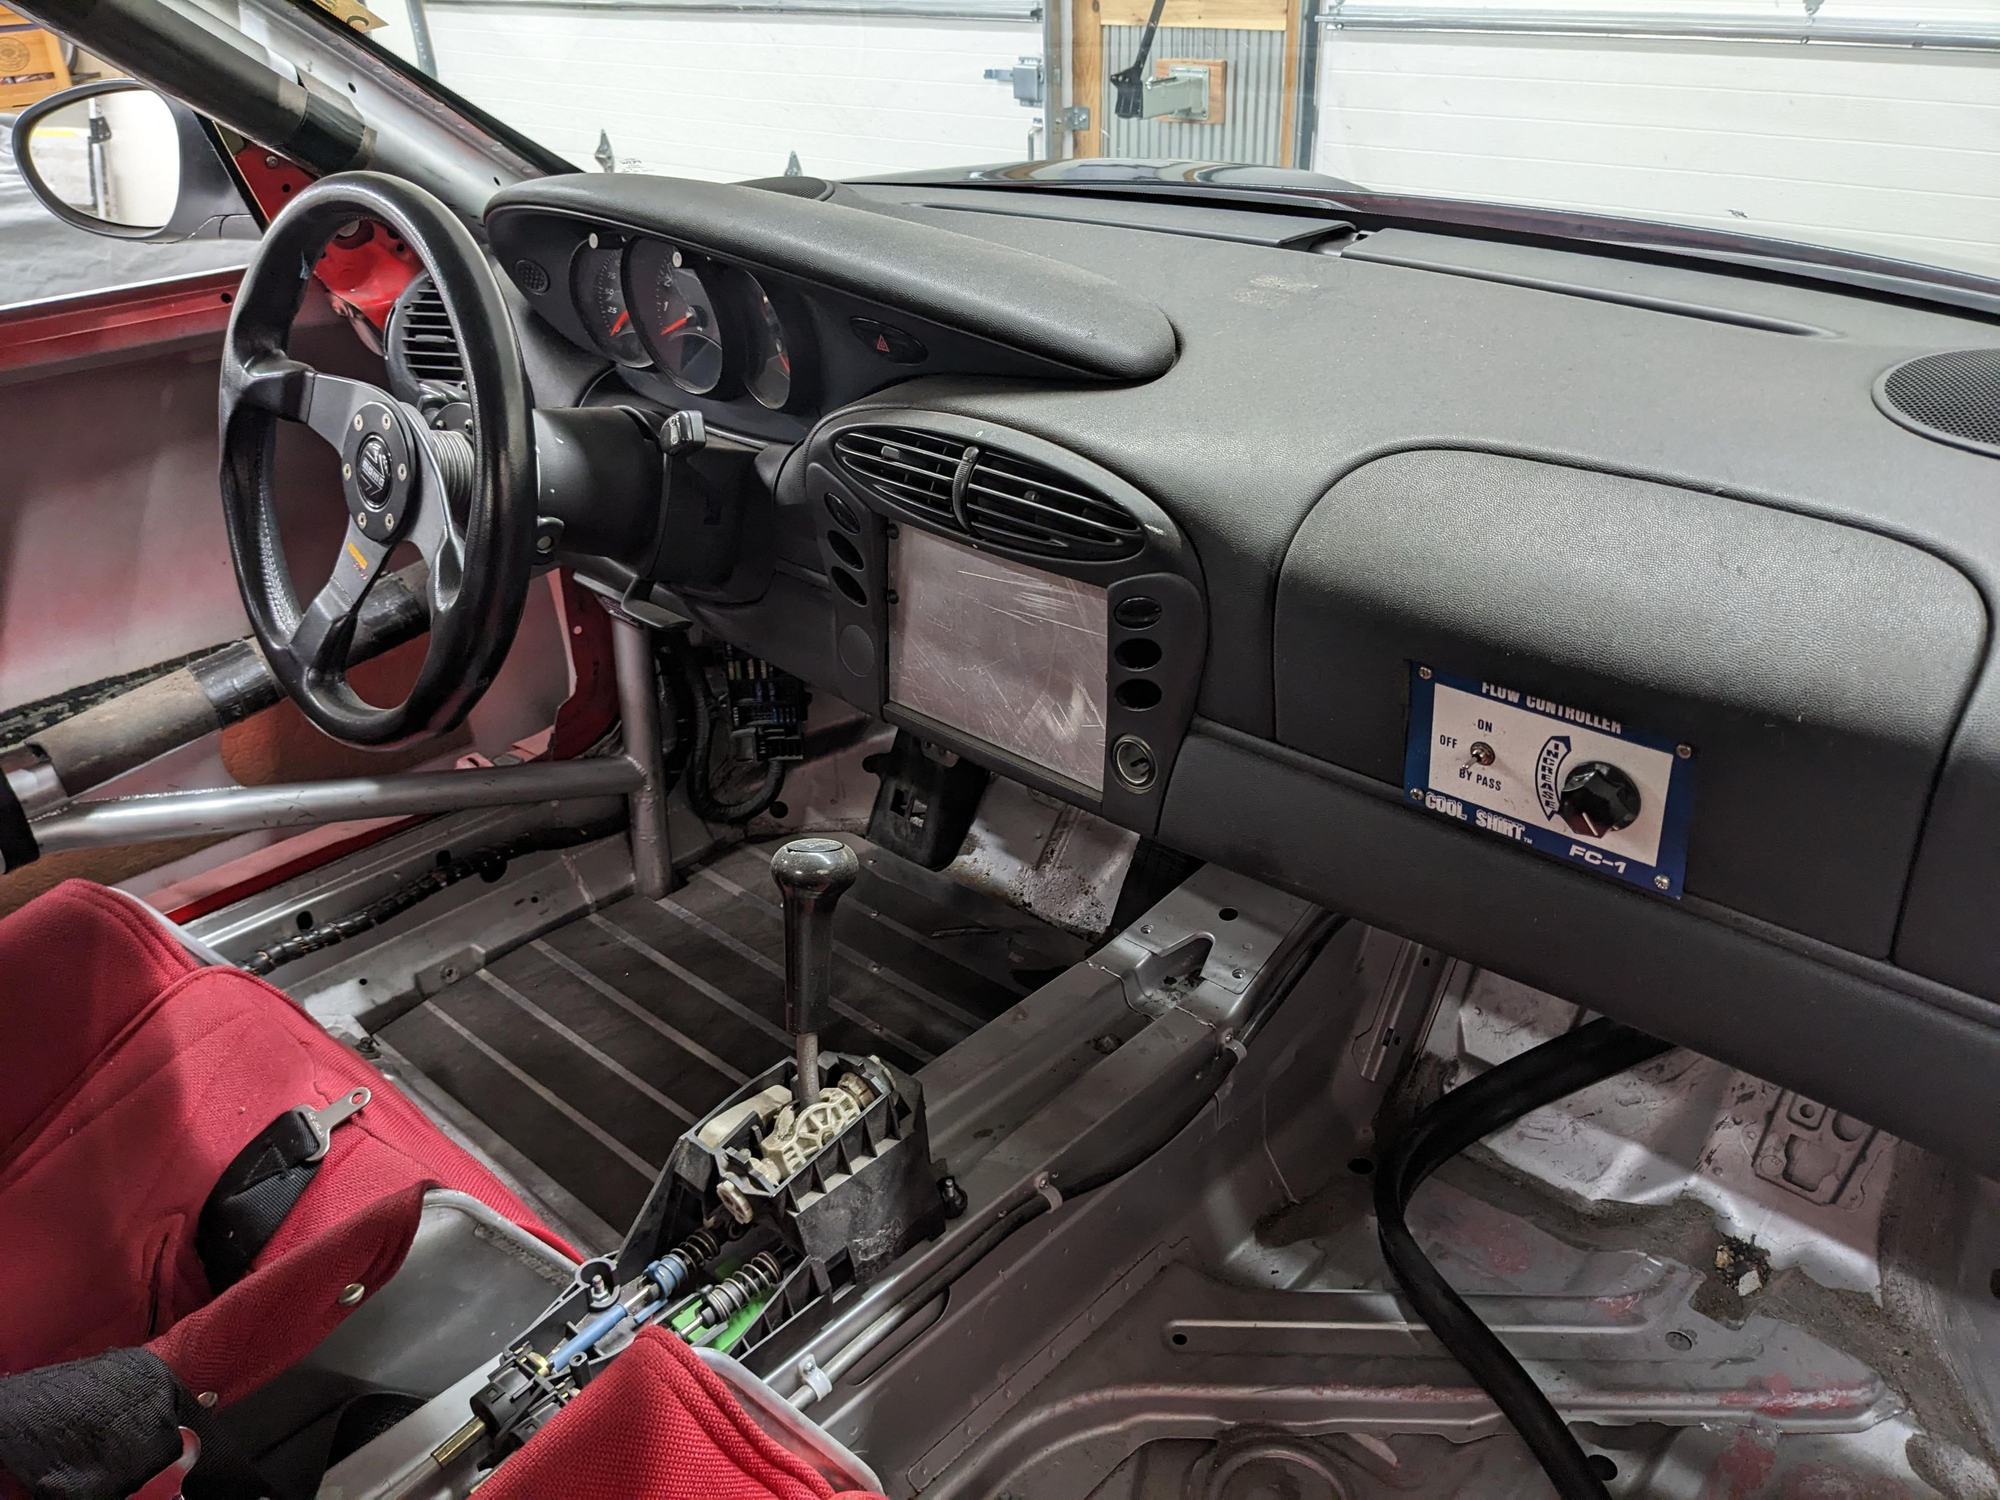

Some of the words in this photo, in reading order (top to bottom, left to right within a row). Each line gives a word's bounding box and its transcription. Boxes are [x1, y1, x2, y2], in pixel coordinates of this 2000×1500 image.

[1481, 681, 1521, 704] FLOW
[1525, 695, 1622, 734] CONTROLLER
[1477, 719, 1493, 733] ON
[1439, 734, 1458, 749] OFF
[1459, 767, 1473, 781] BY
[1476, 773, 1502, 792] PASS
[1540, 742, 1560, 810] INCREASE
[1425, 791, 1467, 821] COOL
[1476, 809, 1526, 841] SHIRT
[1569, 844, 1627, 874] FC-1
